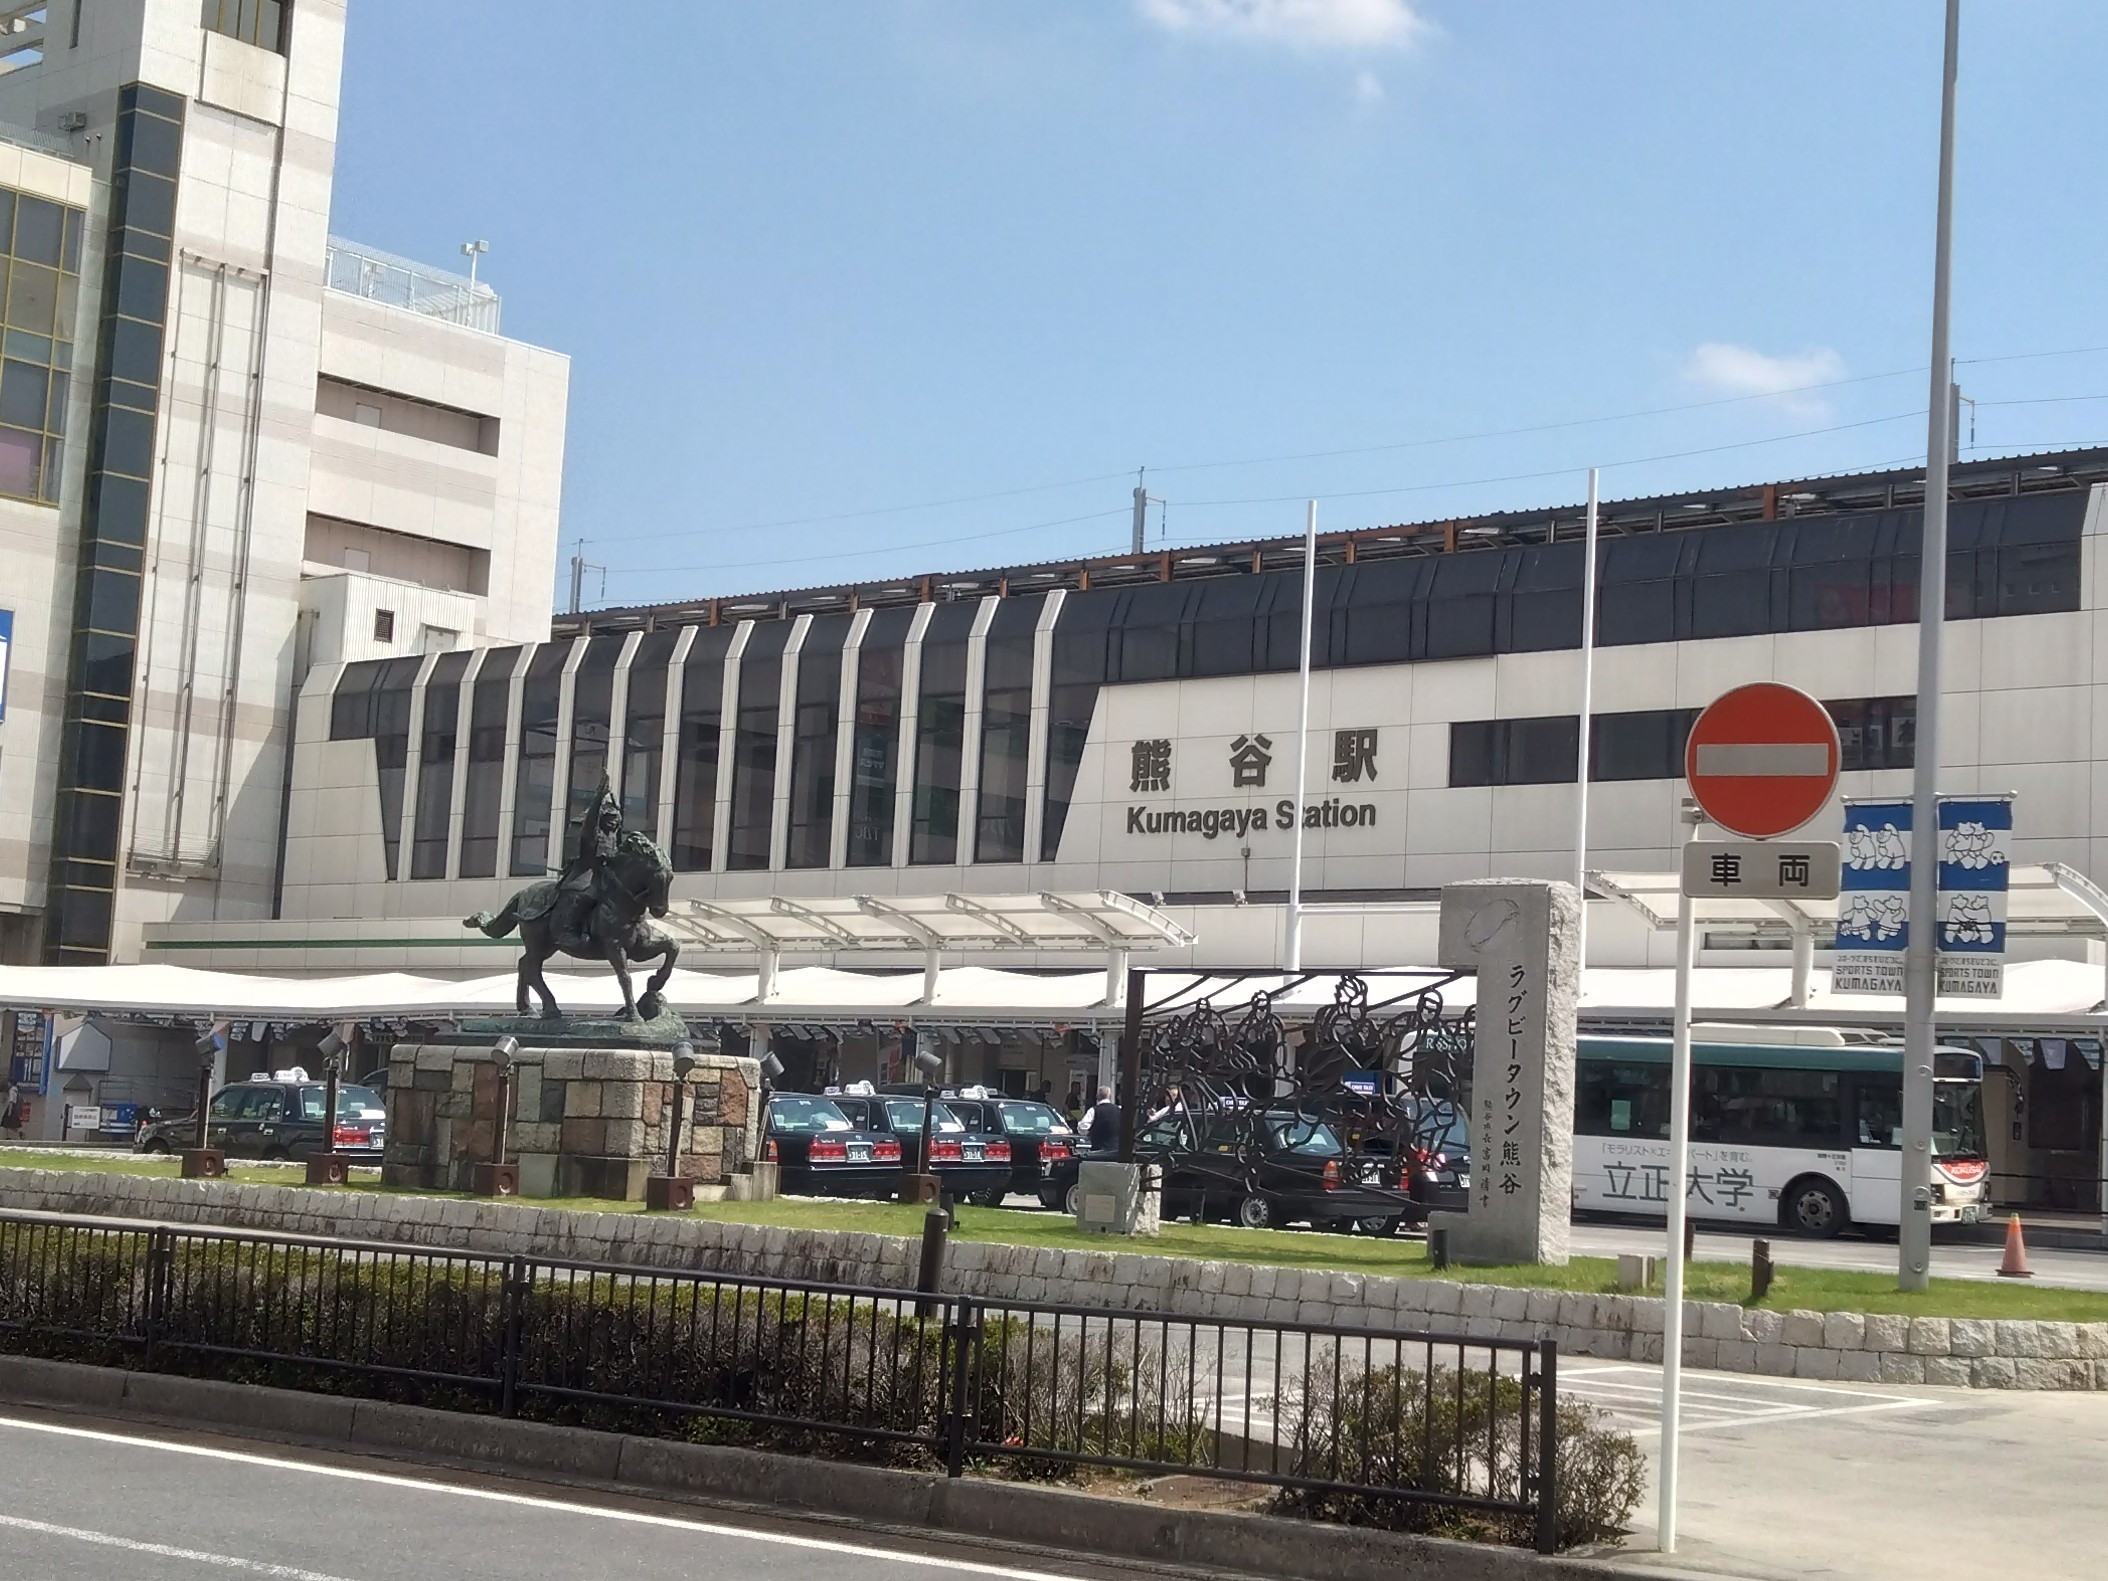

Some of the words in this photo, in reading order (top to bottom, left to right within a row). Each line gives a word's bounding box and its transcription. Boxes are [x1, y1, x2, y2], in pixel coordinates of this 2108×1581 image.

[1129, 729, 1378, 793] 熊谷駅
[1126, 806, 1267, 840] Kumagaya
[1276, 798, 1377, 829] Station
[1710, 853, 1811, 888] 車両
[1836, 965, 1872, 976] SPORTS
[1876, 967, 1904, 977] TOWN
[1939, 968, 1970, 978] SPORTS
[1973, 968, 1999, 978] TOWN
[1835, 977, 1902, 992] KUMAGAYA
[1939, 980, 1998, 994] KUMAGAYA
[1498, 965, 1526, 1195] ラグビータウン熊谷
